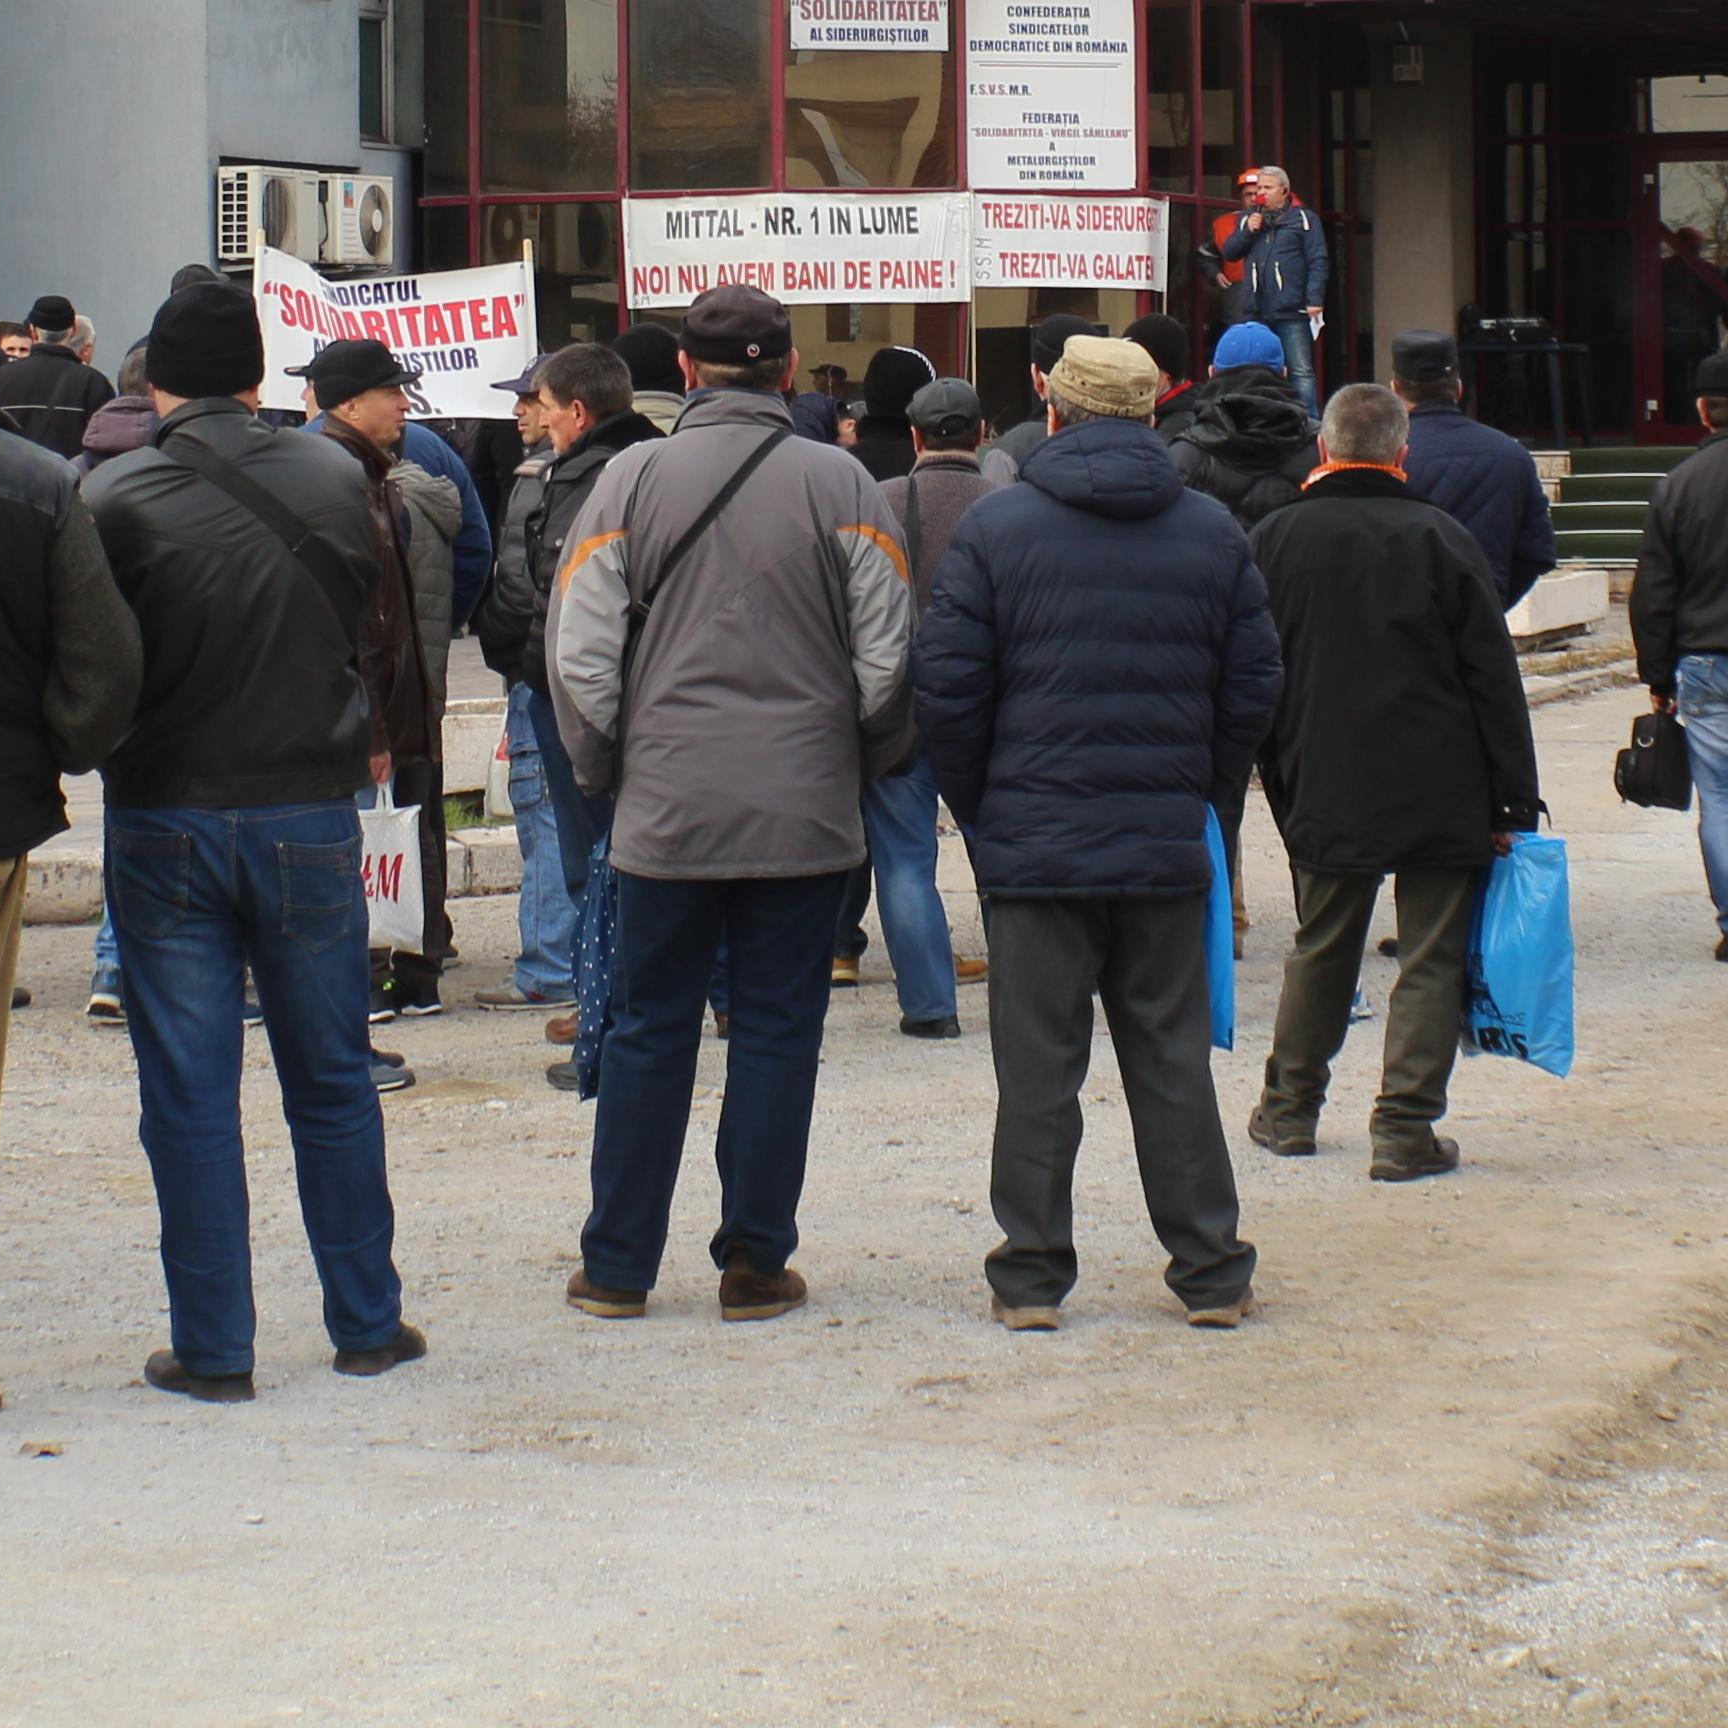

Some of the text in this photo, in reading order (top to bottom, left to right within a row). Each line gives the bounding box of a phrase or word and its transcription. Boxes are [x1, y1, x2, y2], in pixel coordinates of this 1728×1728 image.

[1007, 5, 1091, 21] CONFEDERAȚIA
[810, 28, 929, 45] AL SIDERURGIȘTILOR
[1008, 23, 1090, 36] SINDICATELOR
[969, 39, 1129, 54] DEMOCRATICE DIN ROMÂNIA
[1022, 112, 1080, 128] FEDERAȚIA
[1051, 128, 1081, 138] VIRGIL
[1048, 141, 1056, 152] A
[1007, 155, 1096, 169] METALURGIȘTILOR
[1019, 169, 1085, 181] DIN ROMÂNIA
[665, 209, 744, 240] MITTAL
[764, 206, 802, 236] NR.
[810, 207, 821, 235] 1
[830, 206, 852, 235] IN
[859, 206, 919, 235] LUME
[982, 202, 1071, 229] TREZITI-VA
[999, 252, 1088, 280] TREZITI-VA
[632, 265, 671, 295] NOI
[677, 264, 708, 294] NU
[716, 262, 775, 291] AVEM
[783, 261, 837, 291] BANI
[844, 260, 871, 290] DE
[879, 259, 943, 289] PAINE
